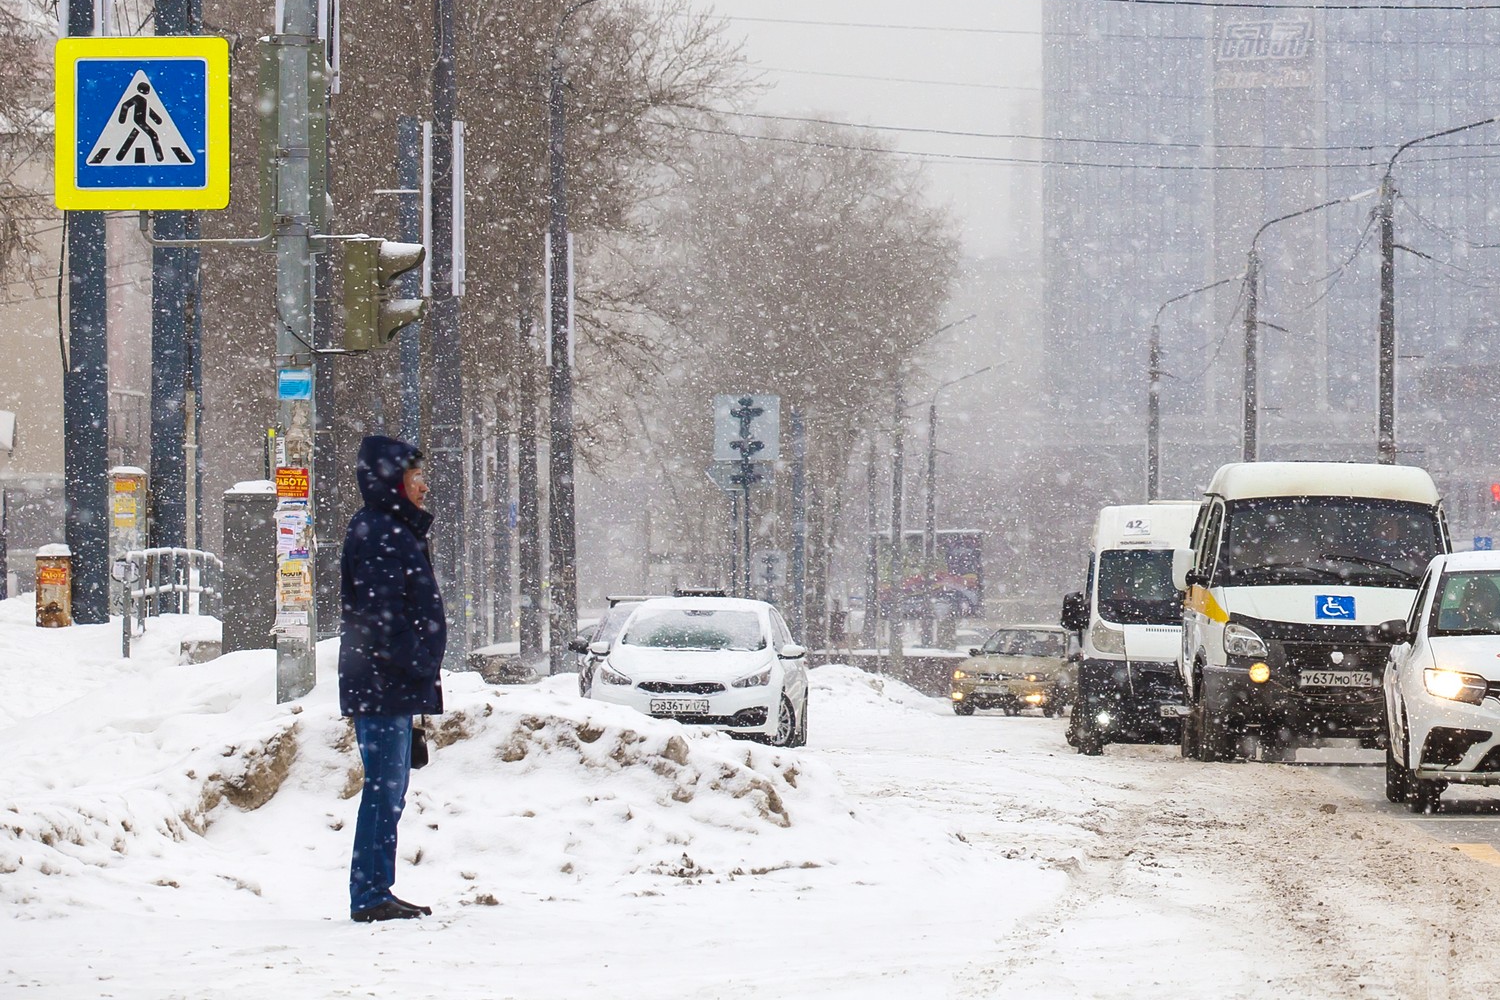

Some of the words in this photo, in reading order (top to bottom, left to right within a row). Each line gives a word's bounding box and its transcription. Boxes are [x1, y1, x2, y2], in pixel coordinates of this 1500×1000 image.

[276, 478, 307, 486] РАБОТА
[1125, 520, 1143, 529] 42
[1305, 672, 1350, 685] У637МО
[1352, 673, 1371, 682] 174
